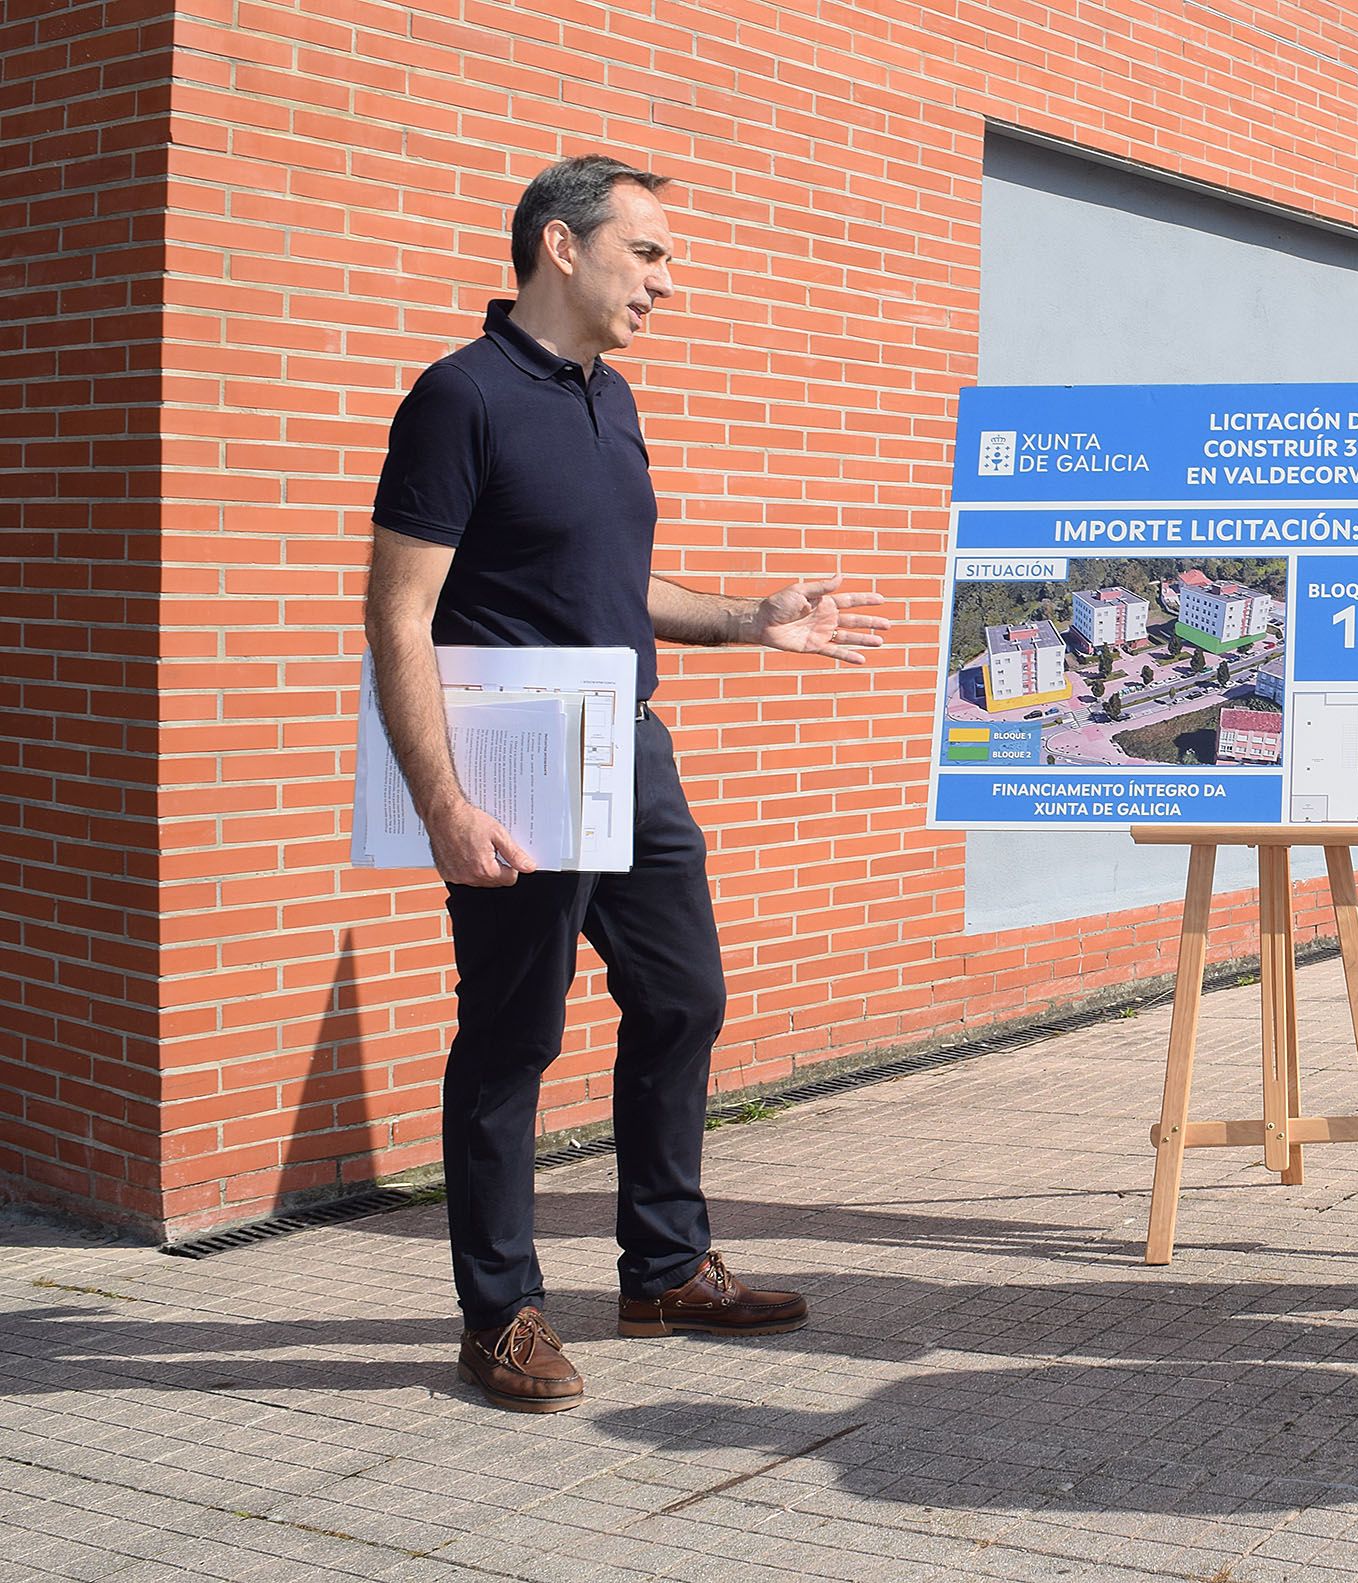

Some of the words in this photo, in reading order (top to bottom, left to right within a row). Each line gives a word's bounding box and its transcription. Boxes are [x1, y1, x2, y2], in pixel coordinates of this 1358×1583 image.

[1210, 408, 1340, 430] LICITACIÓN
[1022, 434, 1100, 450] XUNTA
[1204, 434, 1337, 457] CONSTRUÍR
[1344, 440, 1357, 456] 3
[1020, 455, 1048, 472] DE
[1057, 455, 1149, 472] GALICIA
[1187, 467, 1216, 484] EN
[1055, 520, 1182, 541] IMPORTE
[1192, 513, 1358, 541] LICITACIÓN:
[965, 560, 1055, 578] SITUACIÓN
[1333, 605, 1355, 648] 1
[993, 732, 1024, 740] BLOQUE
[1026, 732, 1032, 740] 1
[992, 751, 1024, 759] BLOQUE
[1025, 751, 1032, 759] 2
[993, 784, 1124, 796] FINANCIAMENTO
[1129, 780, 1199, 796] ÍNTEGRO
[1204, 784, 1226, 796] DA
[1034, 803, 1088, 815] XUNTA
[1093, 803, 1113, 815] DE
[1117, 803, 1181, 815] GALICIA
